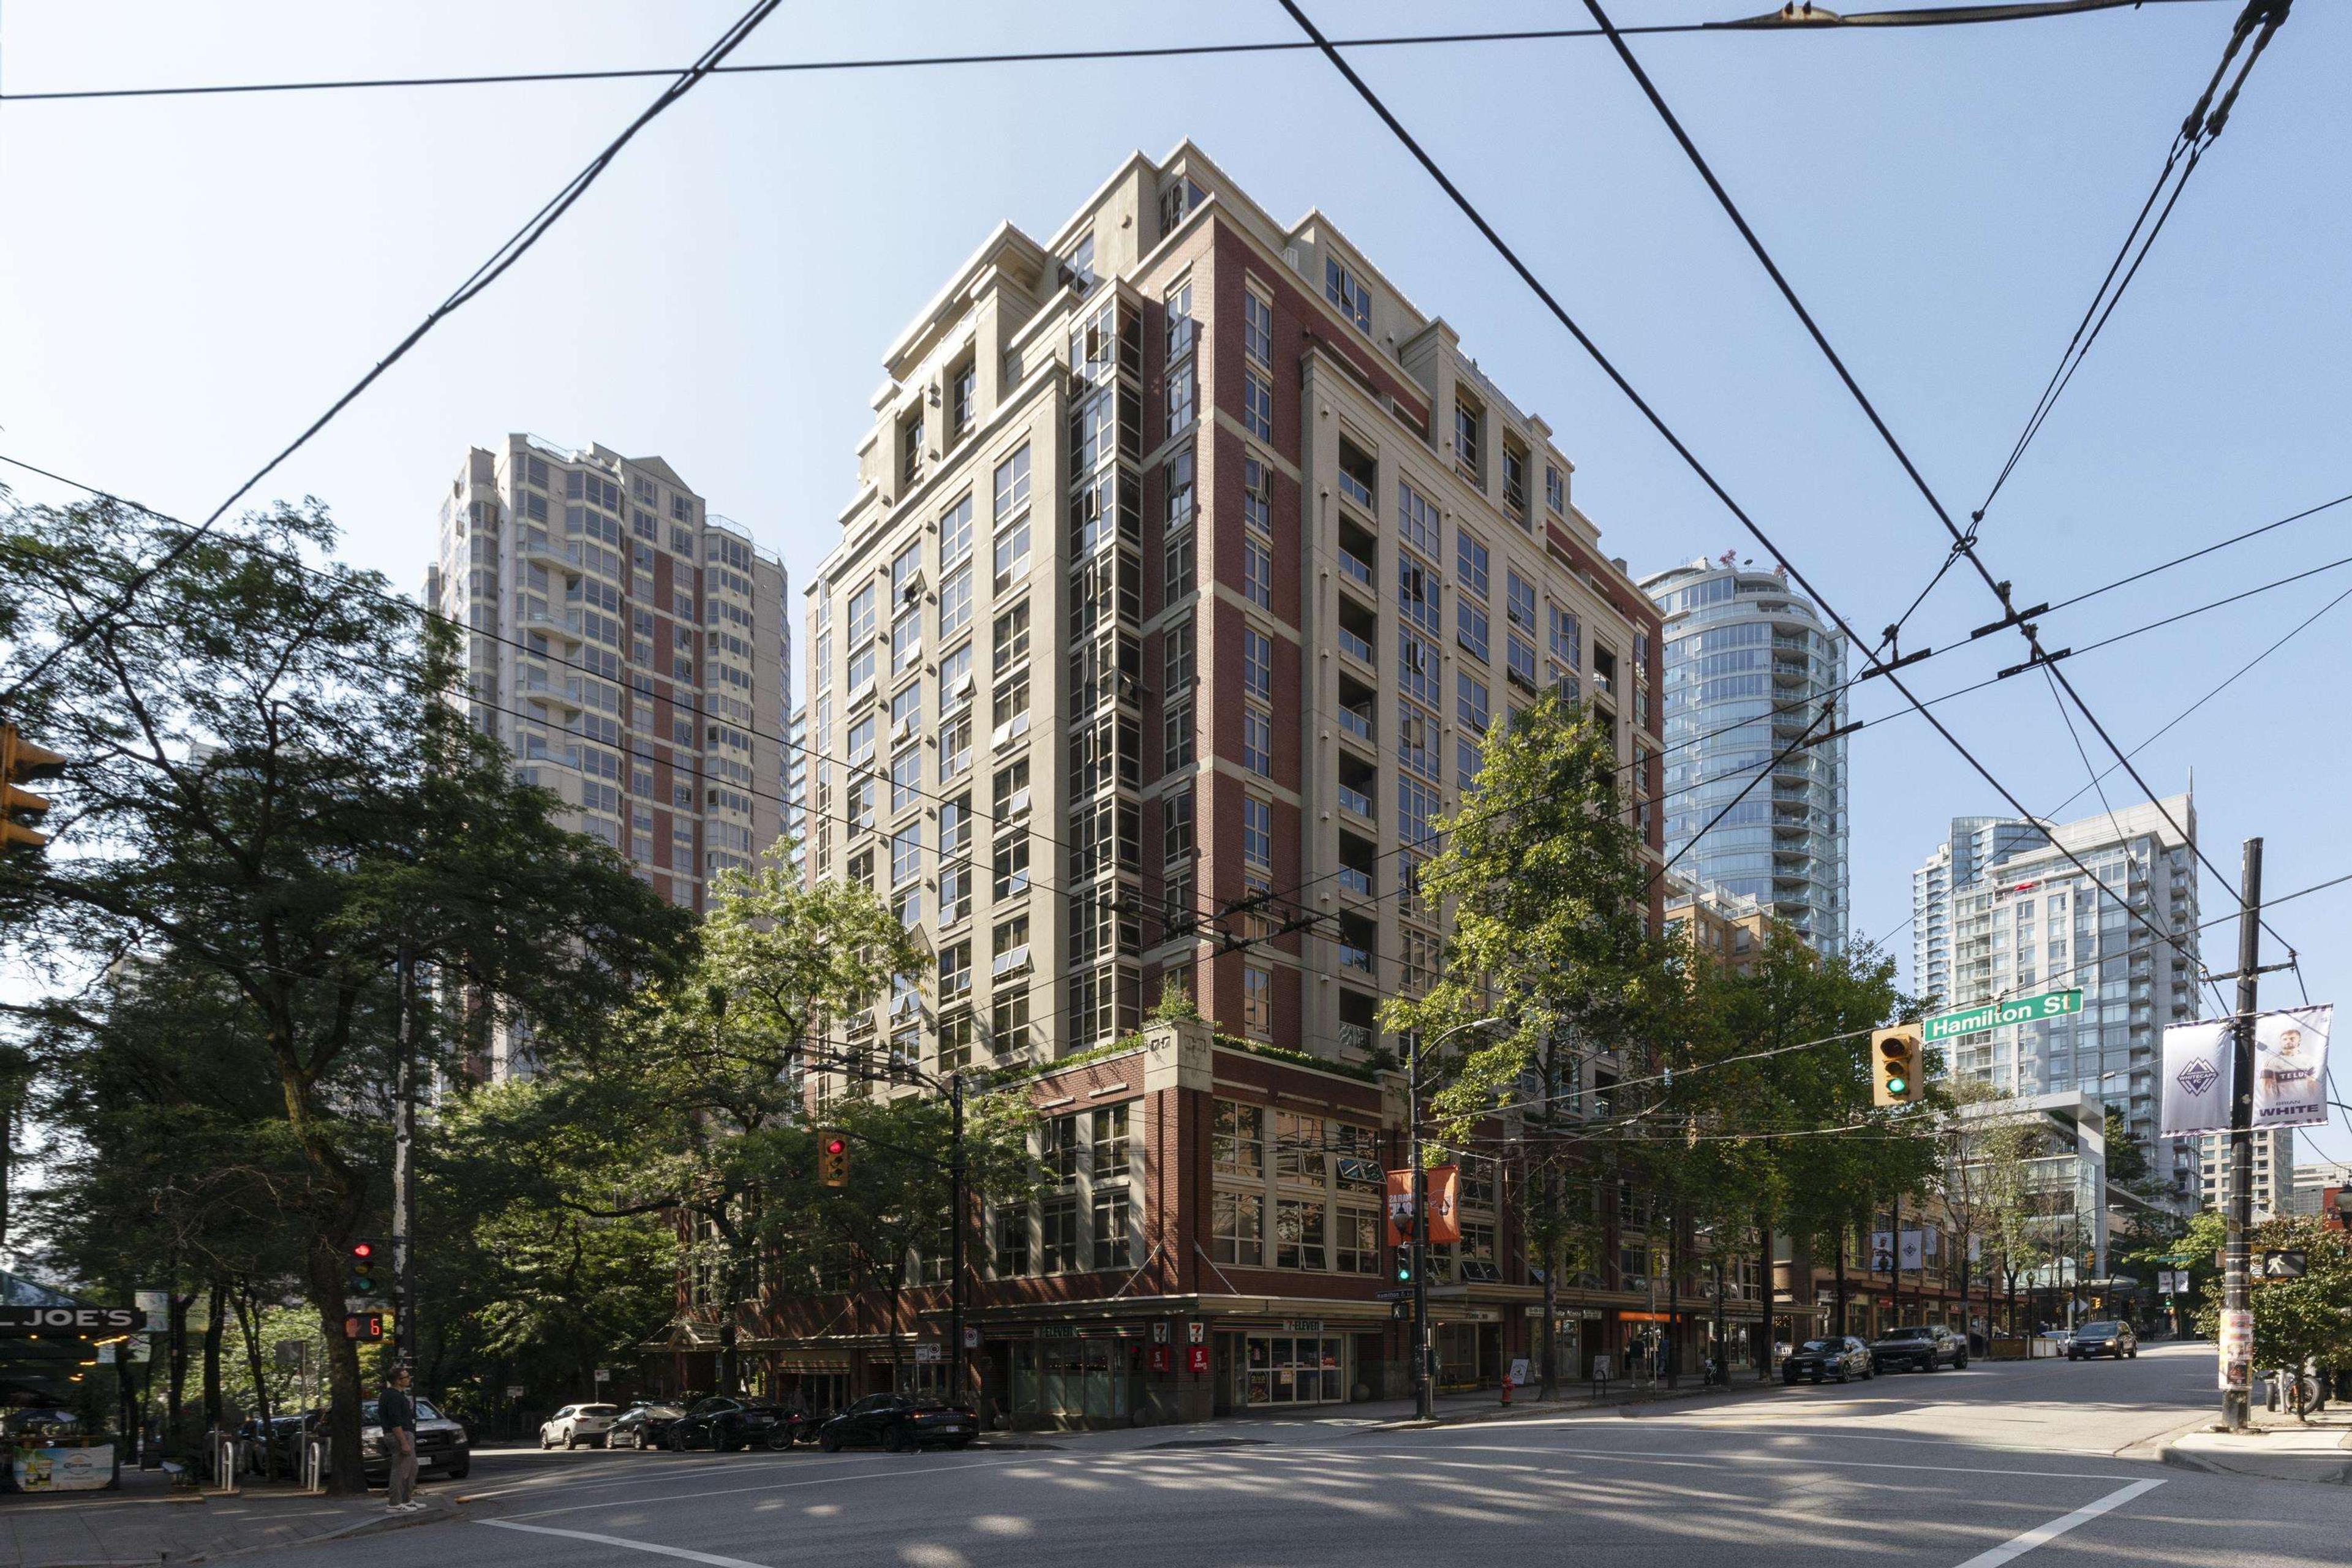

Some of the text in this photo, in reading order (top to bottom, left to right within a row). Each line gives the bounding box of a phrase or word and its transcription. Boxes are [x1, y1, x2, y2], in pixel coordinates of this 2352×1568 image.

[1932, 995, 2070, 1037] Hamilton St
[2179, 1072, 2217, 1081] WHITECAPS
[2259, 1104, 2318, 1117] WHITE
[22, 1309, 134, 1327] JOE'S
[371, 1318, 380, 1335] 6
